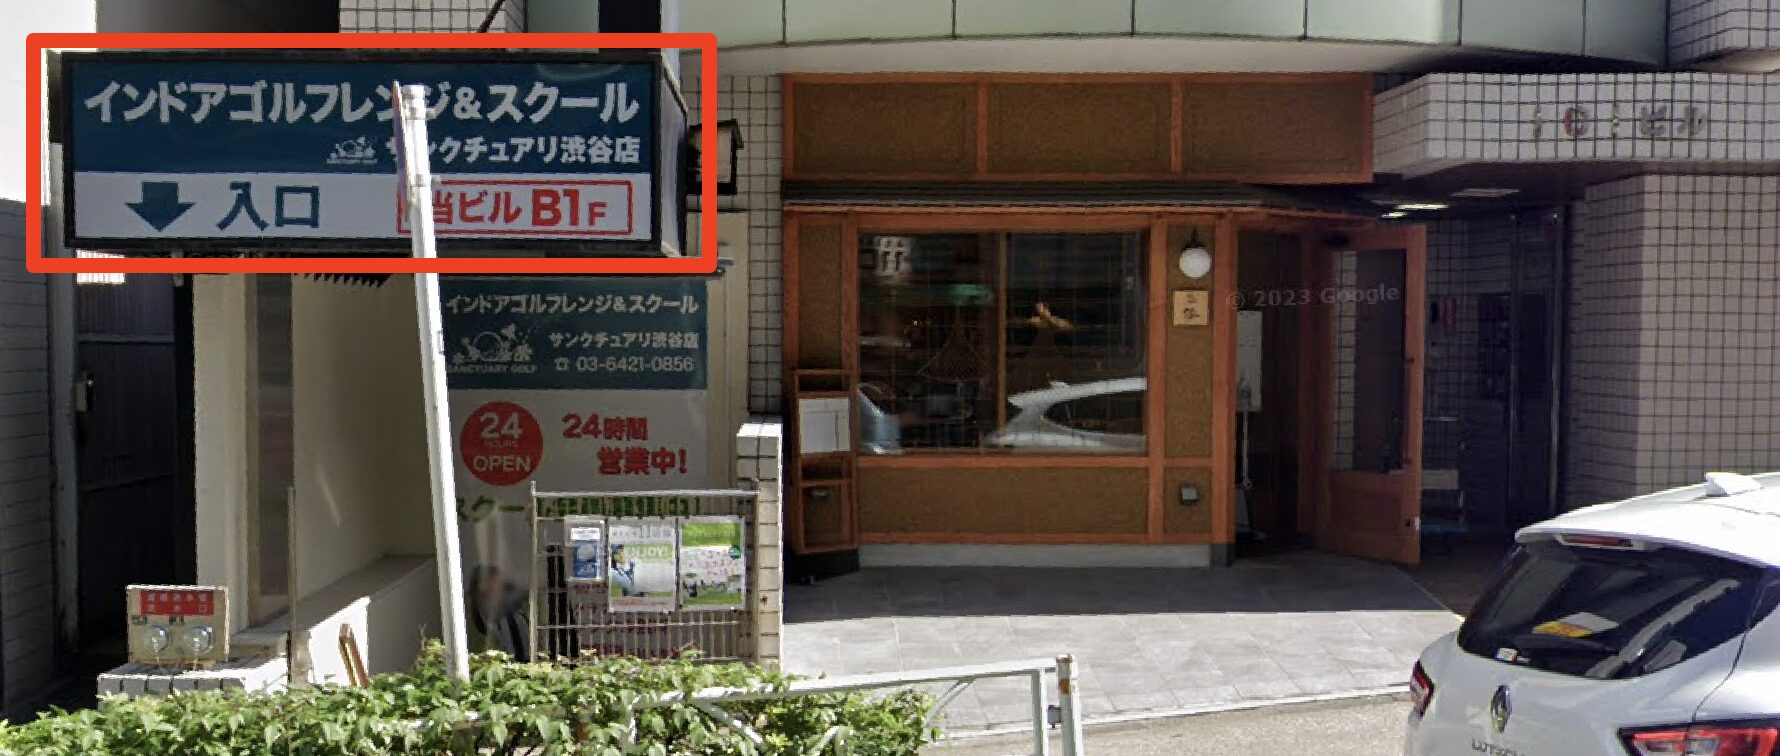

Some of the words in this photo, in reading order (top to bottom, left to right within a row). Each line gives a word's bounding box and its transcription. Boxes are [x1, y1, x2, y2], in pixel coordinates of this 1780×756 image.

[386, 136, 641, 165] クチュアリ渋谷店
[216, 181, 321, 231] 入口
[446, 294, 699, 315] インドアゴルフレンジ&スクール
[576, 356, 696, 373] 03-6421-0856
[480, 412, 523, 439] 24
[562, 412, 649, 442] 24時間
[473, 454, 532, 474] OPEN
